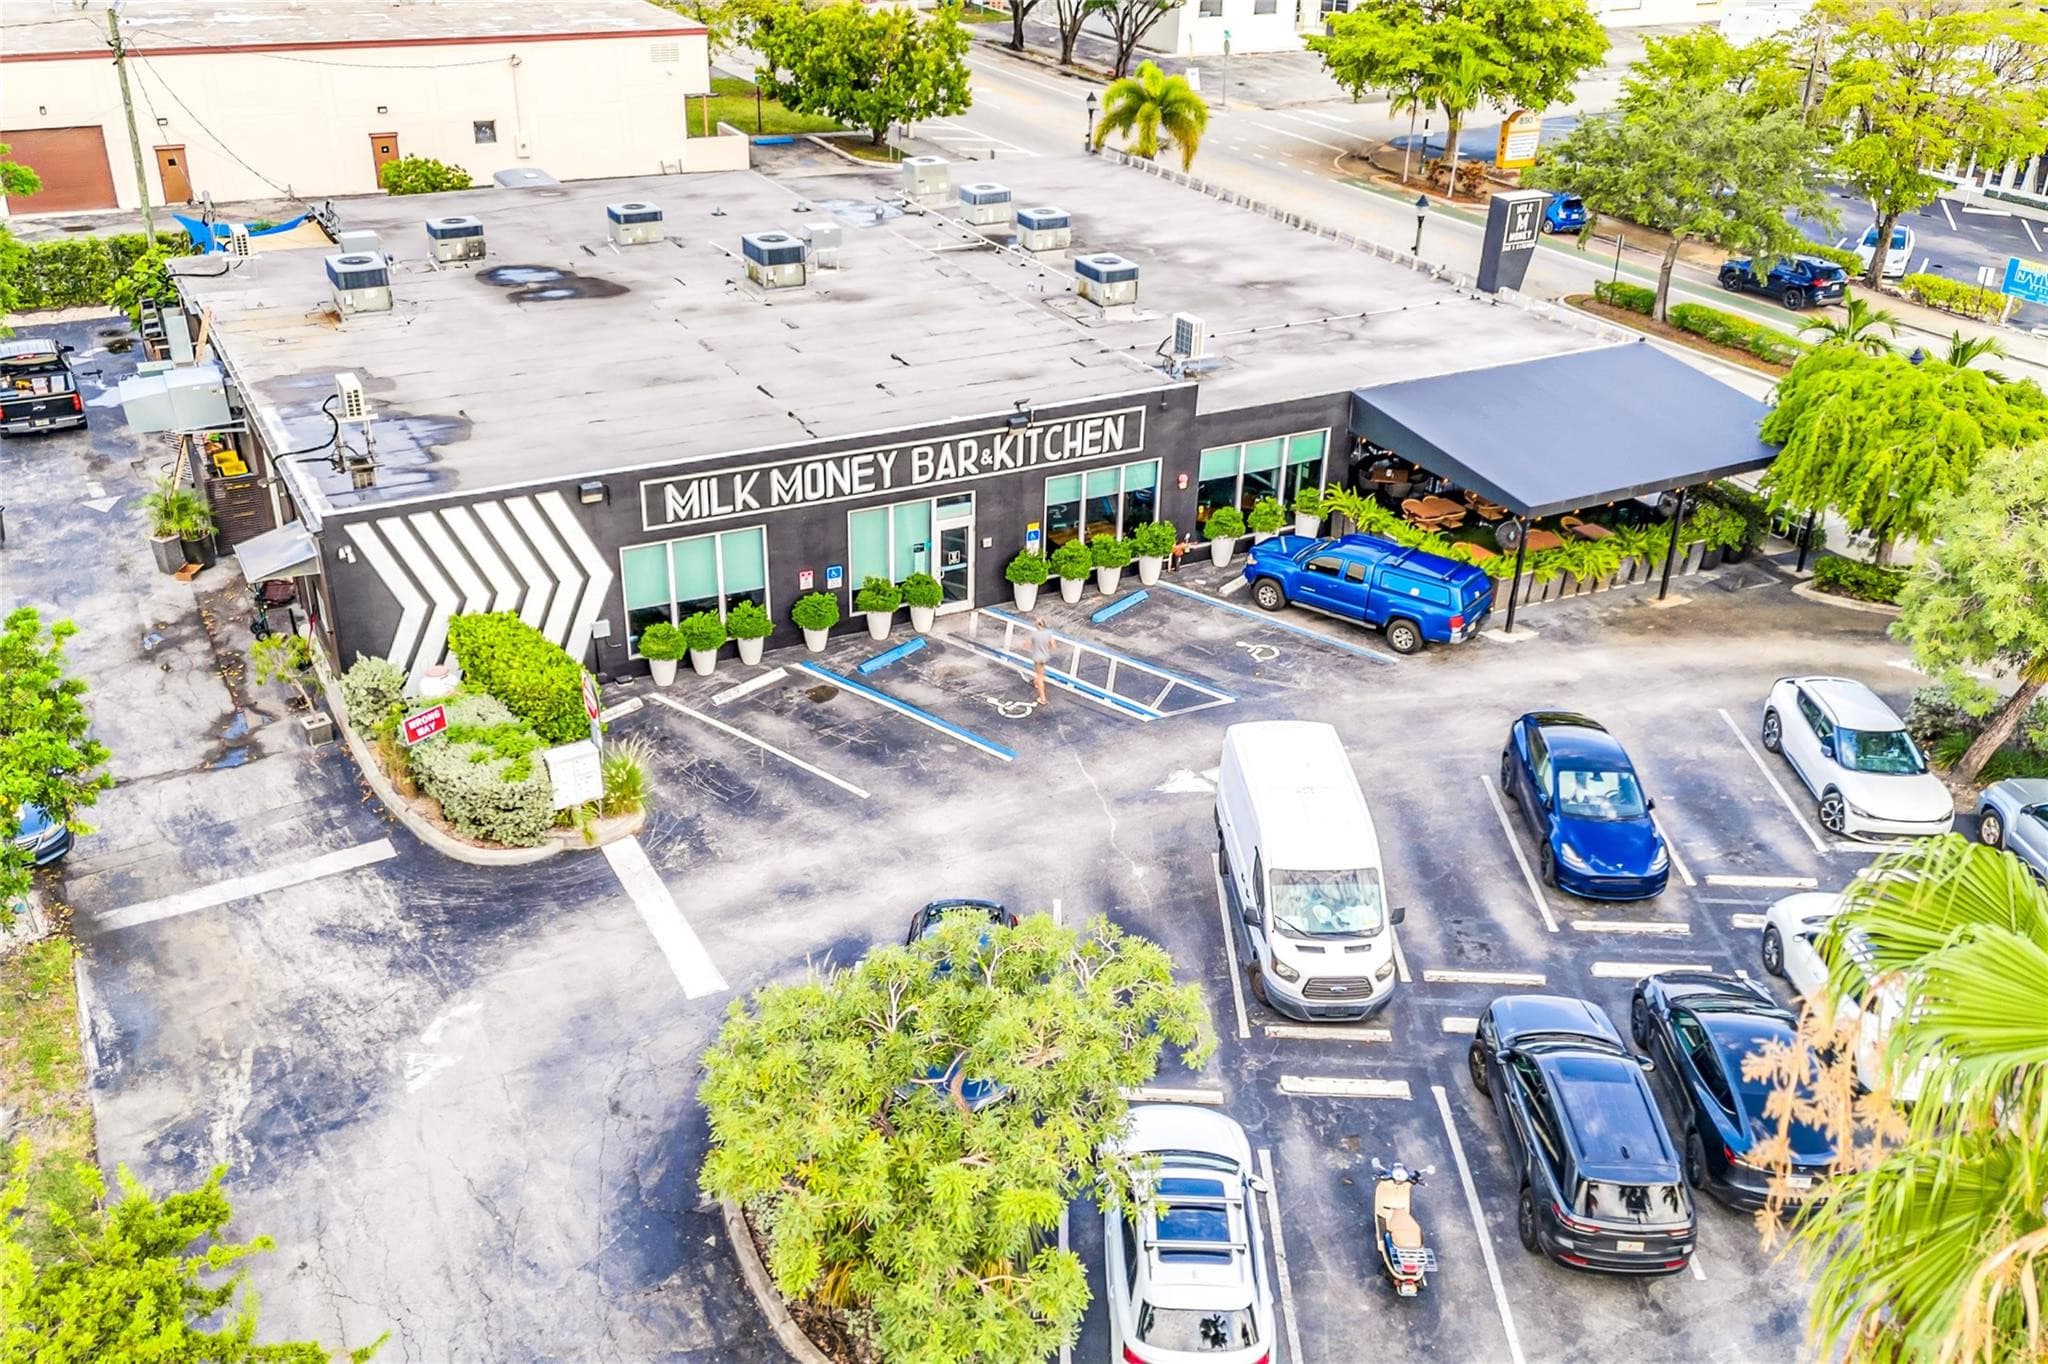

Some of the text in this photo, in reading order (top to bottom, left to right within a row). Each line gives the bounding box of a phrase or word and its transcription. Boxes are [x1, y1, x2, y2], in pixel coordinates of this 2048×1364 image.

[1516, 213, 1530, 231] M
[664, 471, 760, 522] MILK
[769, 450, 898, 506] MONEY
[408, 709, 441, 731] WRONG
[416, 721, 436, 736] WAY
